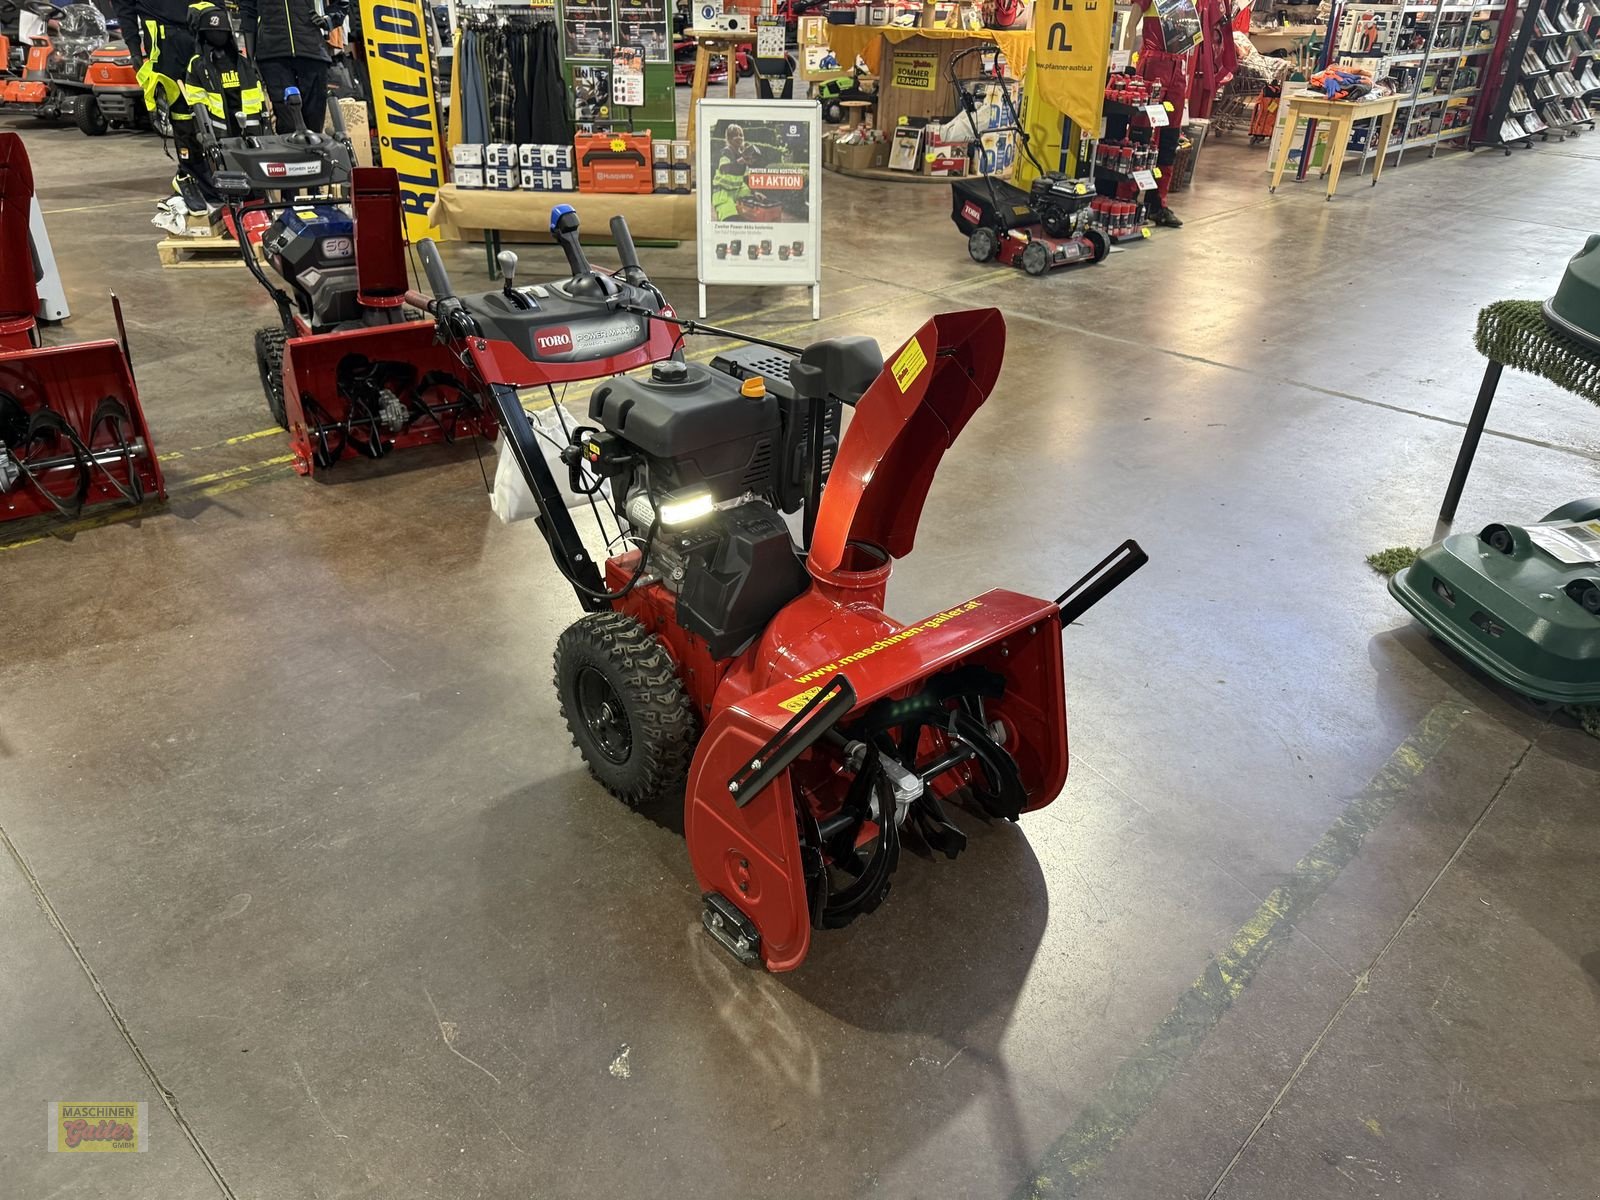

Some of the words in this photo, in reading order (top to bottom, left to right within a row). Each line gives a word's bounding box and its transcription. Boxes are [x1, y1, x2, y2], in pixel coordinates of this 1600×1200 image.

[898, 68, 929, 77] SOMMER
[1036, 62, 1093, 71] ww.pfanner-austria.at
[897, 77, 928, 86] KRACHER
[367, 0, 439, 216] BLÅKLÄD
[751, 175, 764, 187] 1+1
[766, 176, 801, 188] AKTION
[538, 334, 570, 348] TORO
[576, 329, 609, 342] POWER
[794, 600, 983, 683] www.maschinen-gailer.at
